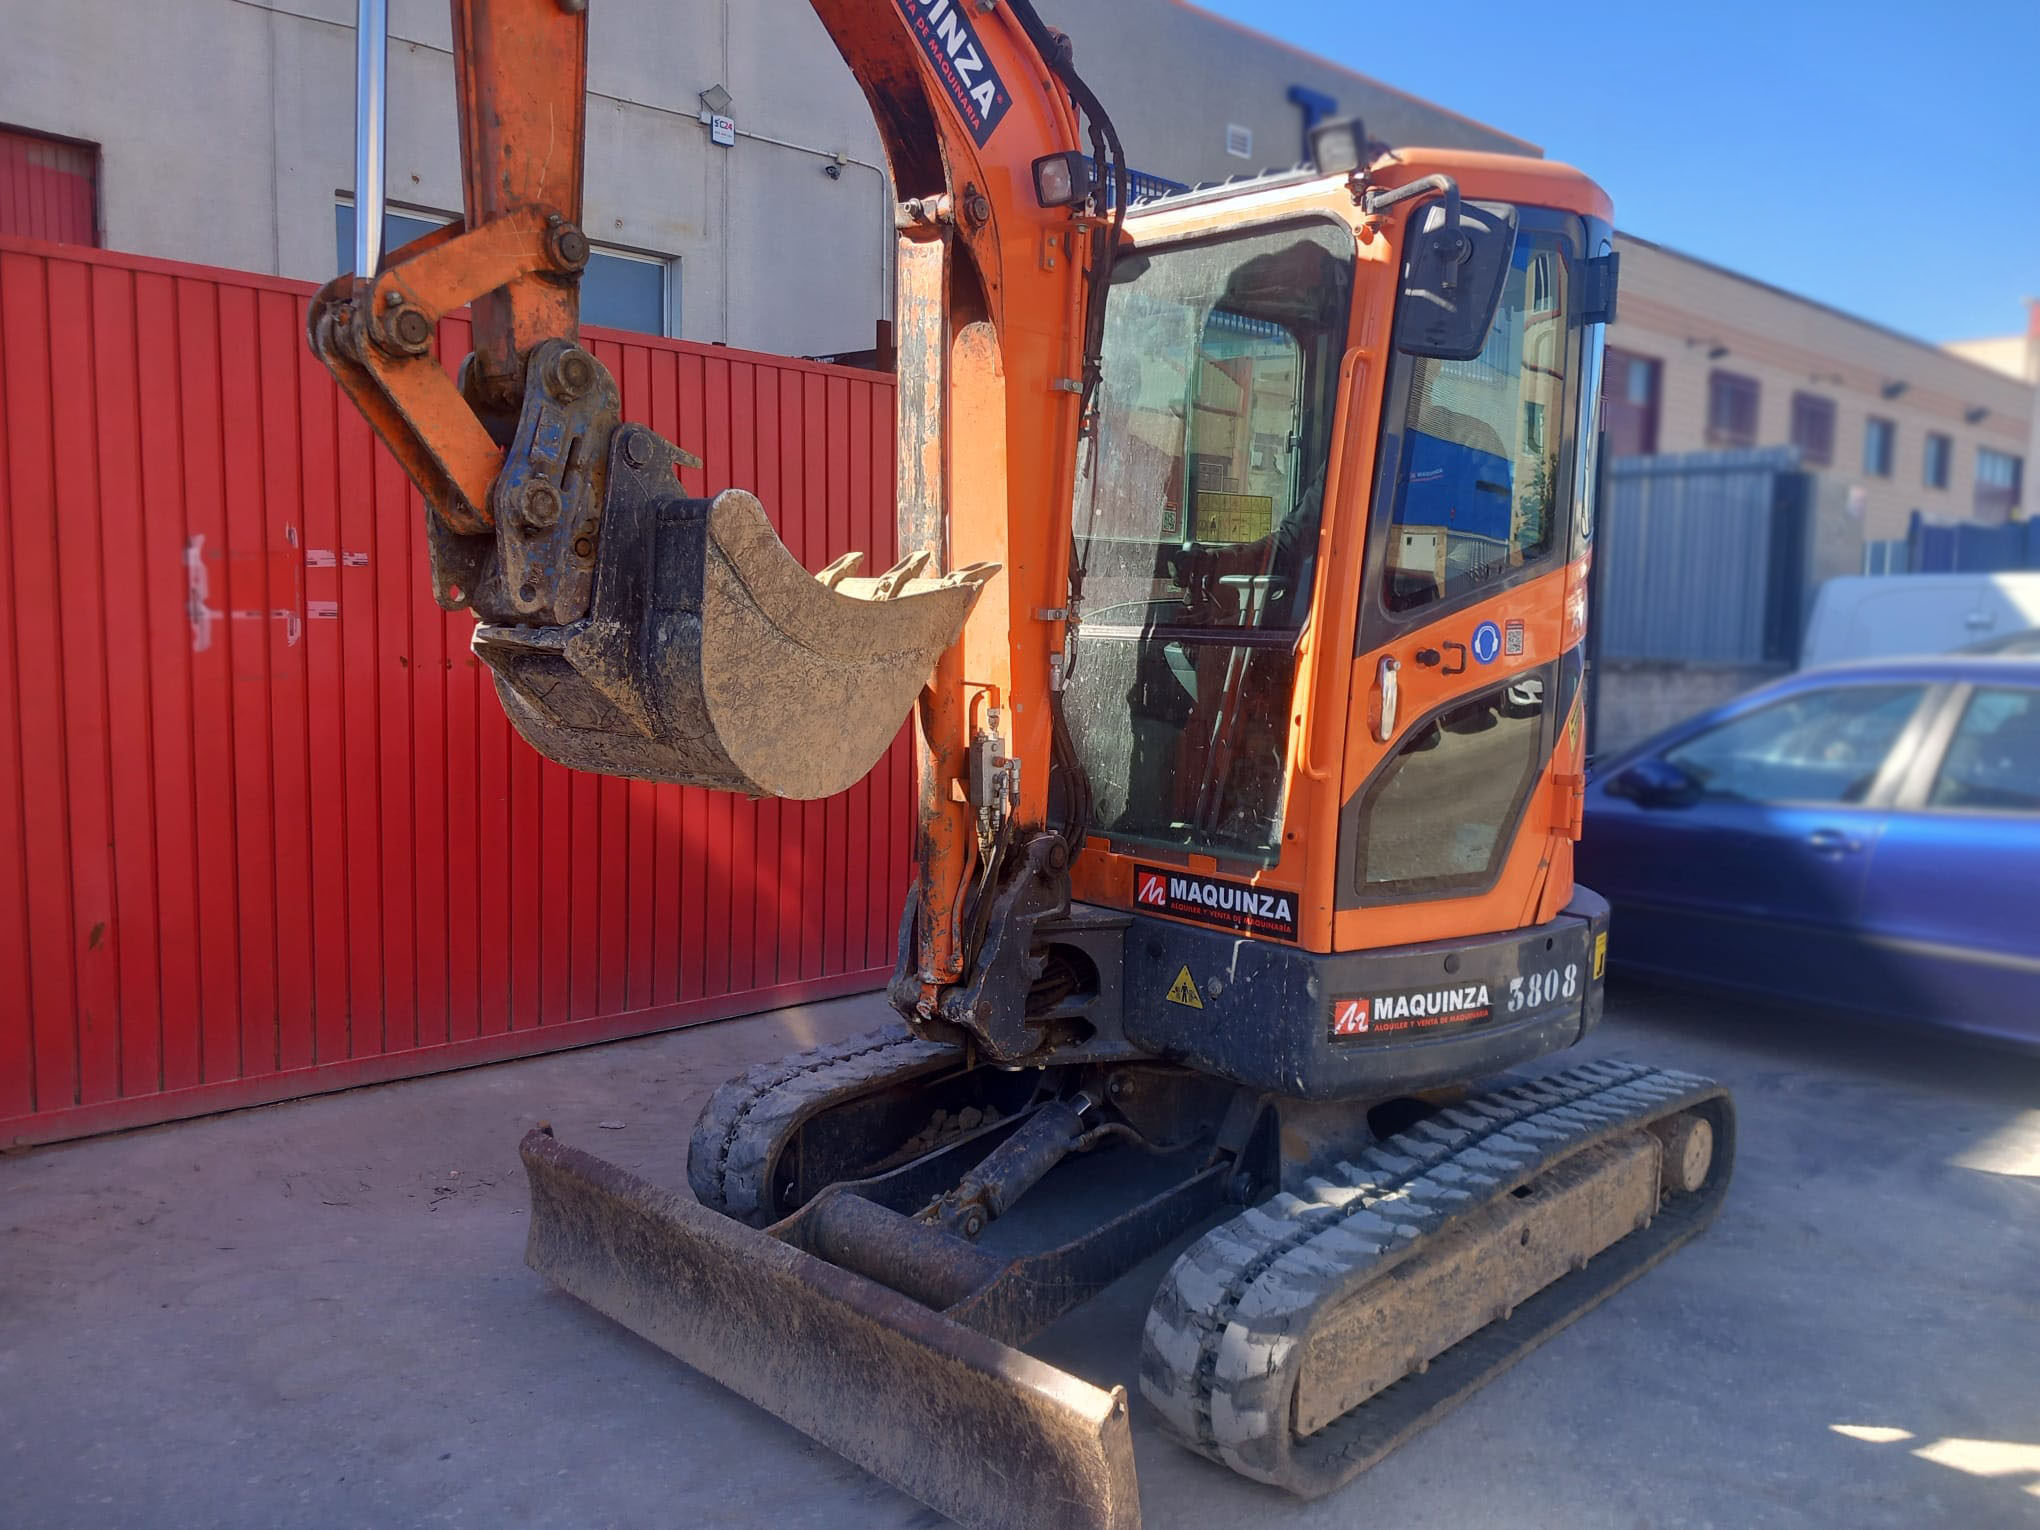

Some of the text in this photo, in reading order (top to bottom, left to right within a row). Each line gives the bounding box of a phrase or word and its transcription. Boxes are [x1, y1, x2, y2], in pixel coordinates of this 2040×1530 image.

[916, 17, 930, 37] DE
[918, 0, 996, 120] INZA
[1170, 877, 1292, 922] MAQUINZA
[1170, 902, 1201, 915] ALQUILER
[1210, 910, 1231, 921] VENTA
[1374, 985, 1490, 1020] MAQUINZA
[1507, 963, 1578, 1012] 3808
[1374, 1020, 1408, 1031] ALQUILER
[1416, 1017, 1438, 1027] VENTA
[1440, 1016, 1448, 1024] DE
